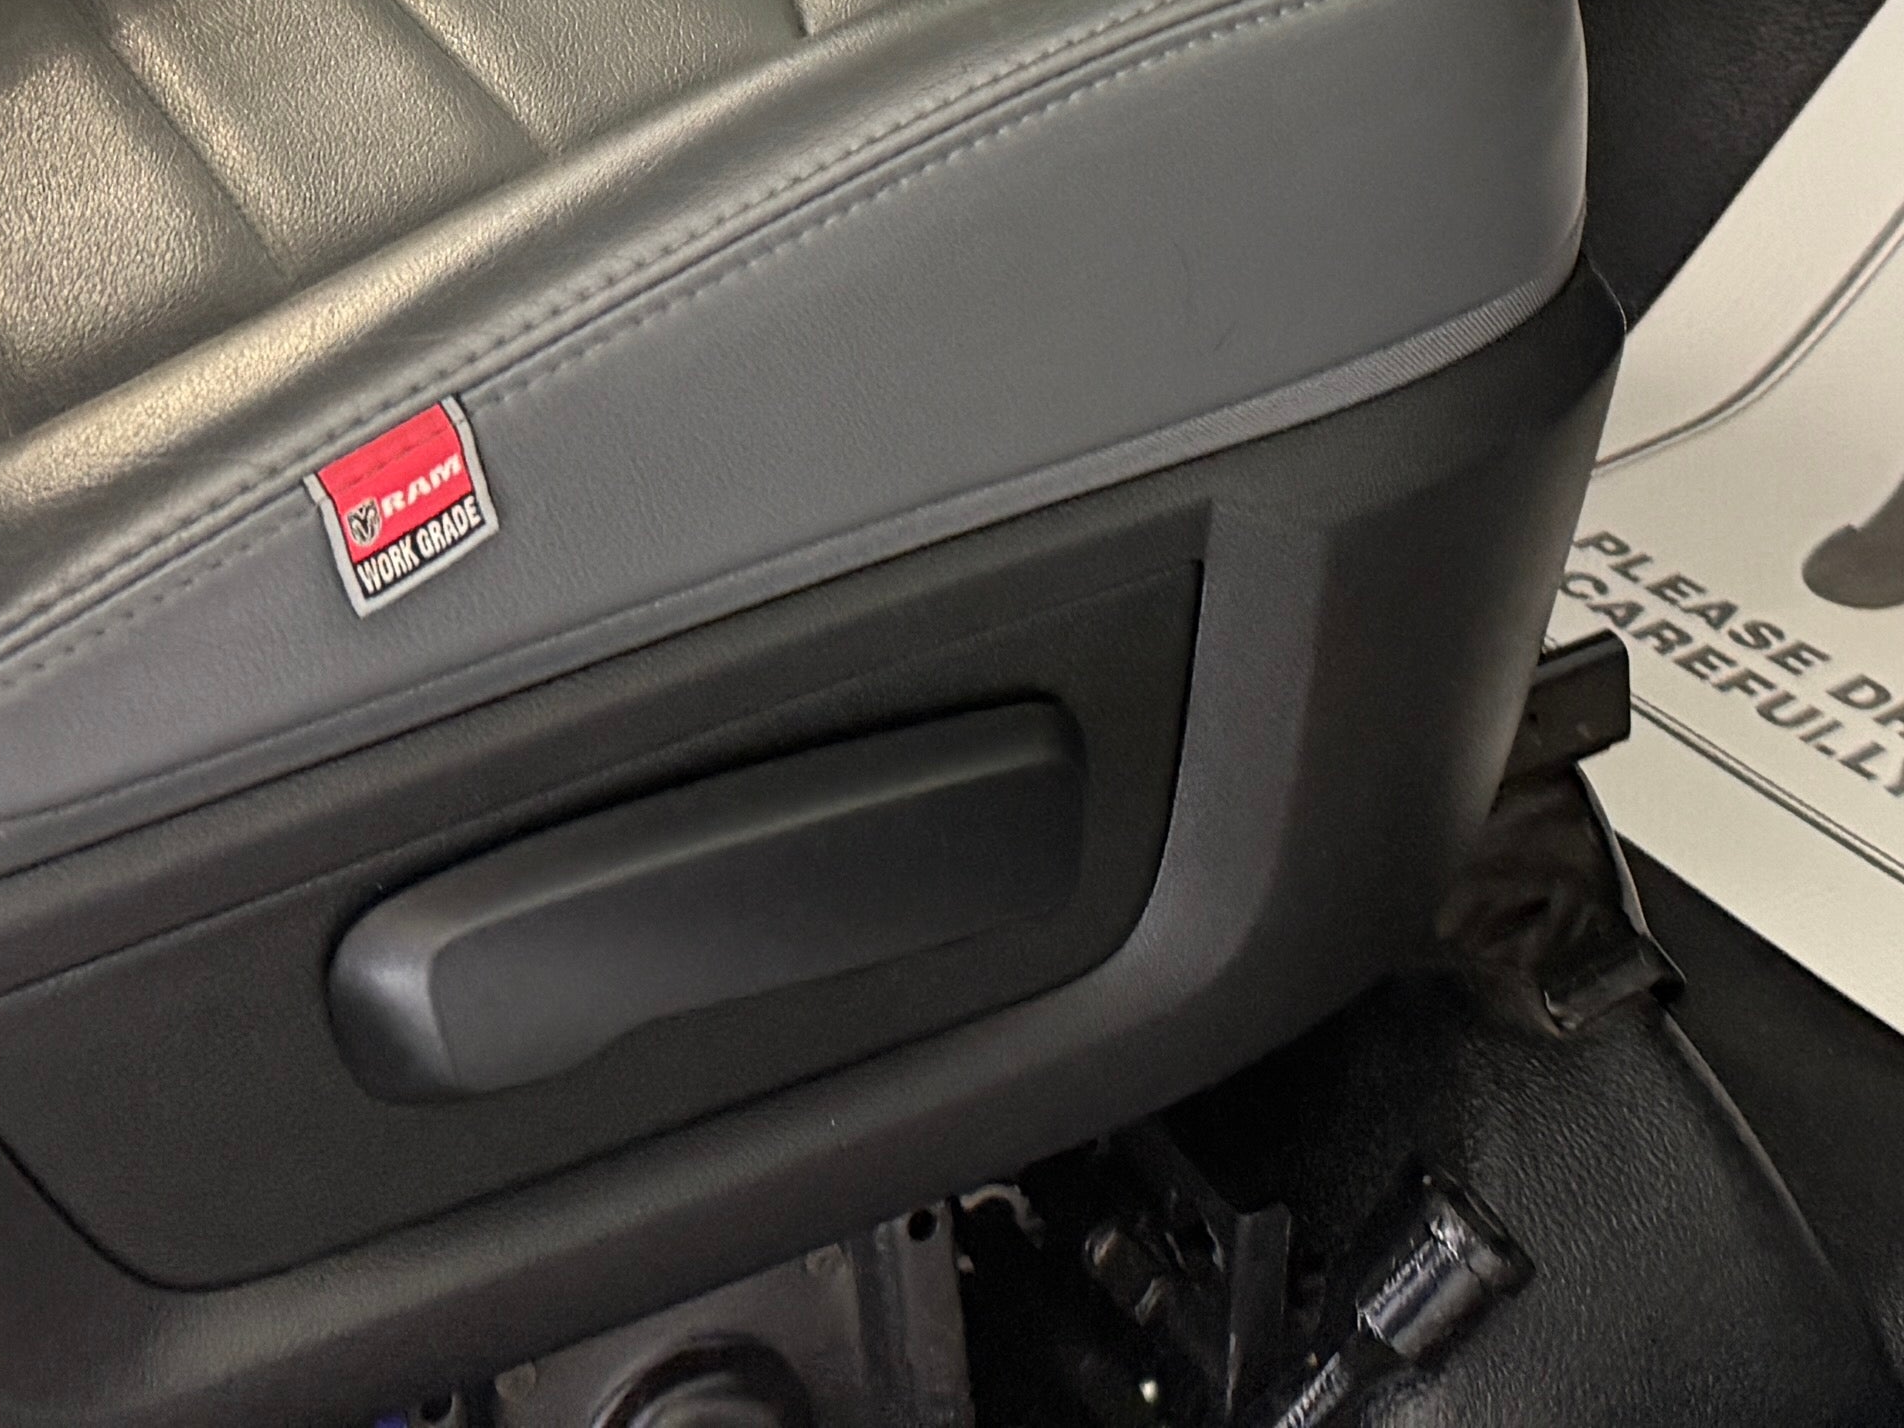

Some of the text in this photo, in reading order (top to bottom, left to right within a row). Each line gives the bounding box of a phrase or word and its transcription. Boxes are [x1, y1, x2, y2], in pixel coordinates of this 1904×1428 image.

[381, 452, 462, 518] RAM
[357, 495, 482, 594] WORK GRADE
[1573, 530, 1830, 676] PLEASE
